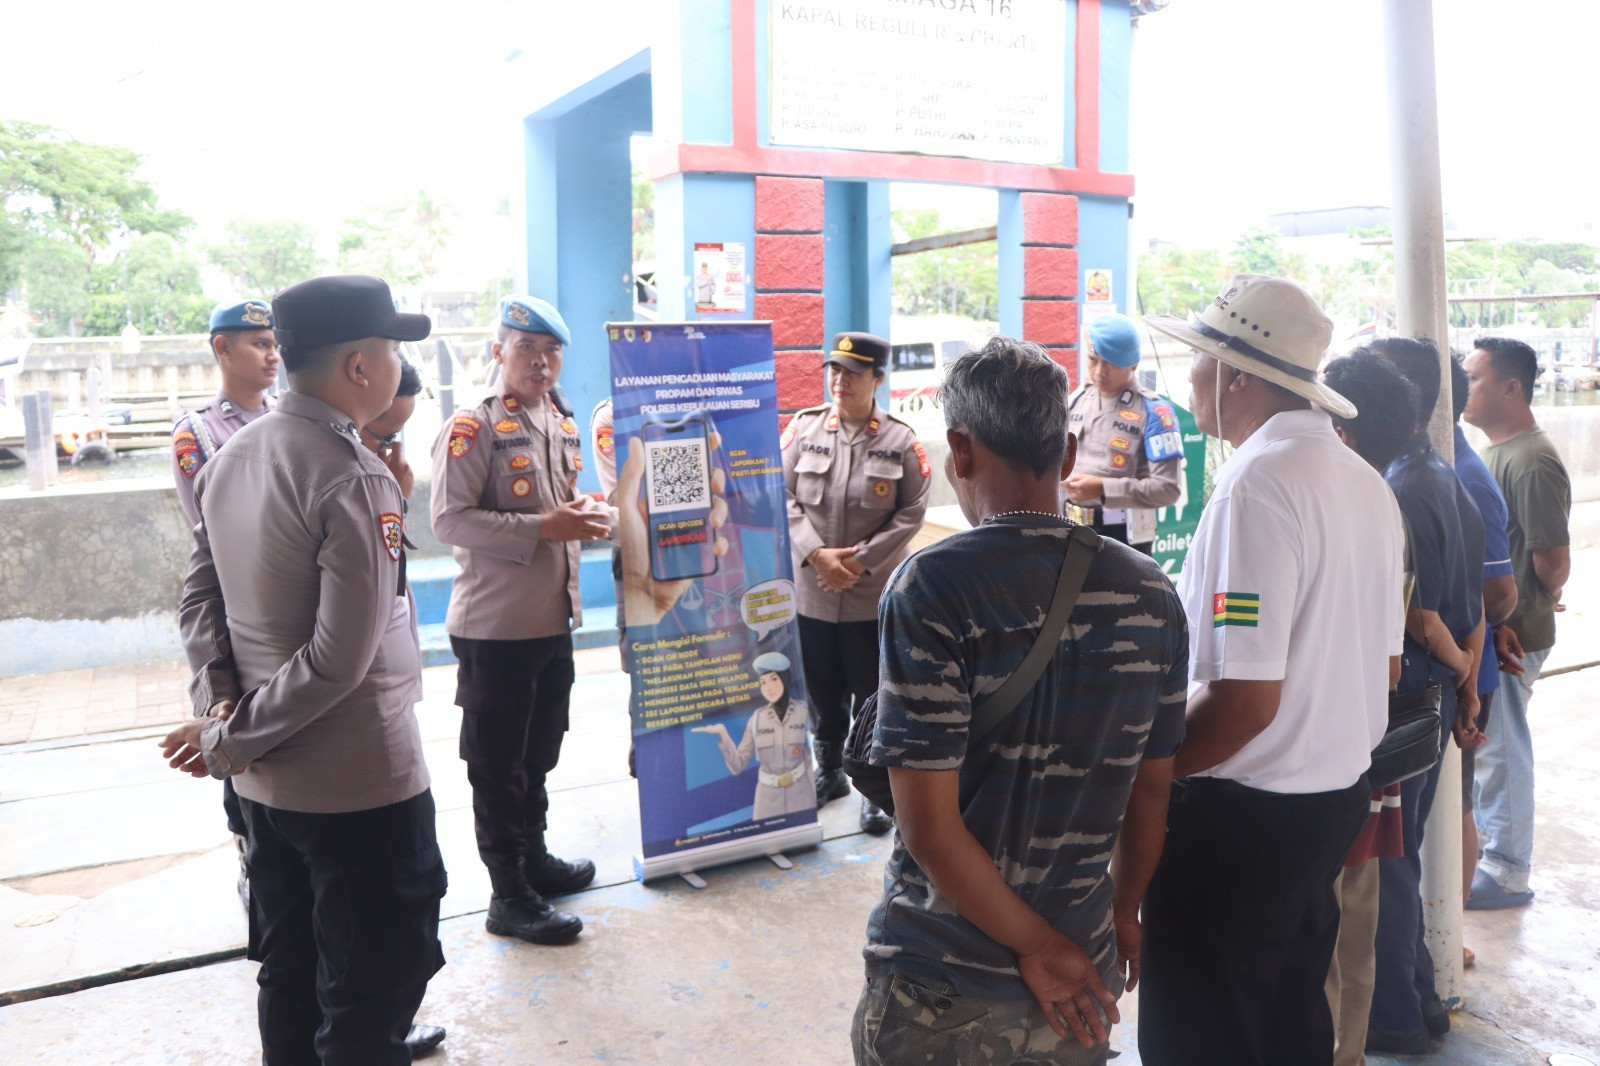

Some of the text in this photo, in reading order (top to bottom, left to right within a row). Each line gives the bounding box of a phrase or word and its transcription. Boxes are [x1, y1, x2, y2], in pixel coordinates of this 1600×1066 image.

[781, 4, 848, 27] KAPAL
[855, 13, 946, 40] REGULER
[797, 105, 840, 118] TIDUNG
[909, 106, 946, 121] PUTRI
[822, 120, 868, 134] RESORT
[615, 371, 775, 387] LAYANAN PENGADUAN MASYARAKAT
[655, 386, 743, 399] PROPAM DAN SIWAS
[640, 399, 760, 415] POLRES KEPULAUAN SERIBU
[729, 449, 747, 457] SCAN
[658, 518, 705, 530] SCAN QR CODE
[1151, 532, 1193, 553] Toilet
[632, 641, 657, 652] Cara
[657, 636, 691, 649] Mengisi
[692, 630, 726, 643] Formulir
[641, 654, 666, 664] SCAN
[679, 649, 699, 659] KODE
[642, 652, 743, 675] KLIK PADA TAMPILAN MENU
[694, 663, 739, 677] PENGADUAN
[644, 672, 749, 697] MENGISI DATA DIRI PELAPOR
[644, 680, 760, 707] MENGISI NAMA PADA TERLAPOR
[645, 693, 751, 718] ISI LAPORAN SECARA DETAIL
[646, 712, 703, 729] BESERTA BUKTI
